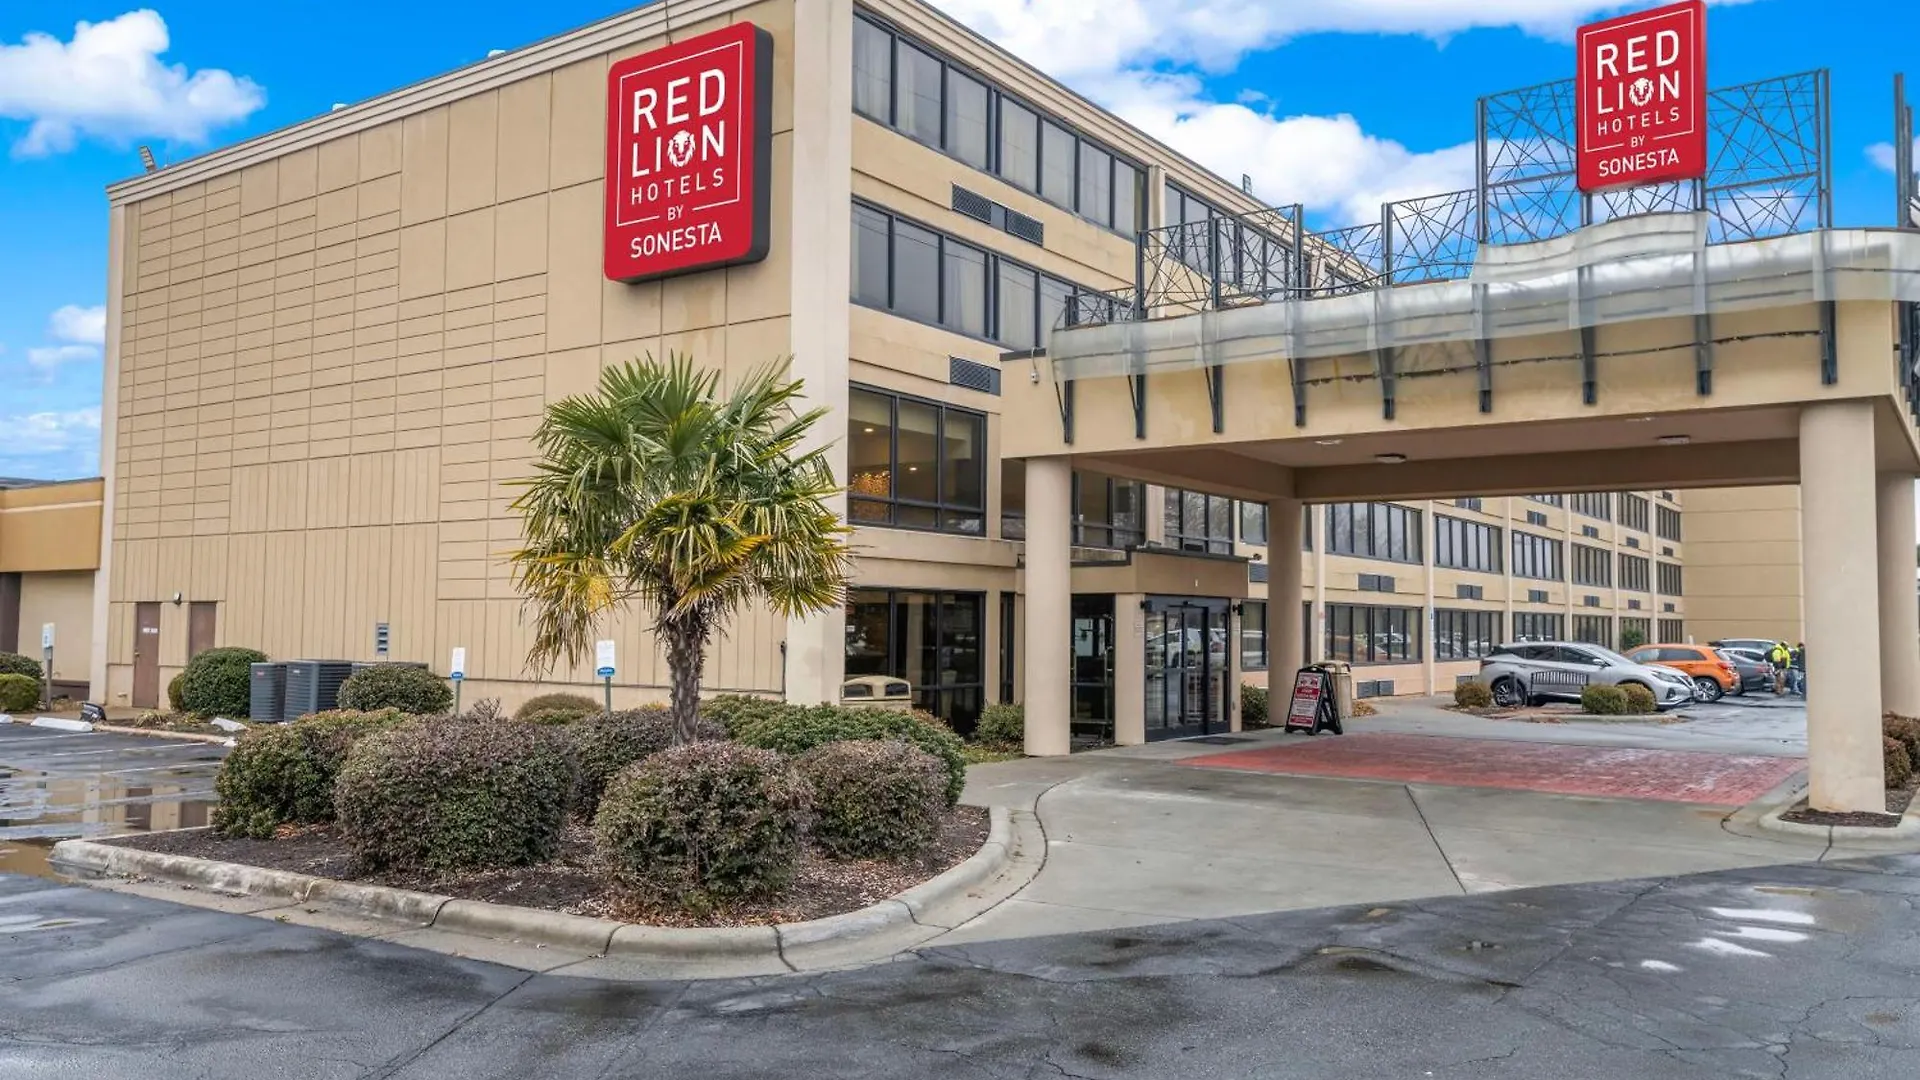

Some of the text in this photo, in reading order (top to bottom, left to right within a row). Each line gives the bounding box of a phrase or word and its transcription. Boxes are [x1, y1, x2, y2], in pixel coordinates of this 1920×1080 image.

[1596, 29, 1680, 80] RED
[633, 68, 726, 134] RED
[1597, 70, 1680, 114] LION
[1597, 106, 1680, 136] HOTELS
[631, 120, 725, 178] LION
[1631, 135, 1645, 148] BY
[1598, 147, 1680, 177] SONESTA
[631, 167, 724, 205] HOTELS
[667, 205, 684, 221] BY
[630, 221, 723, 259] SONESTA
